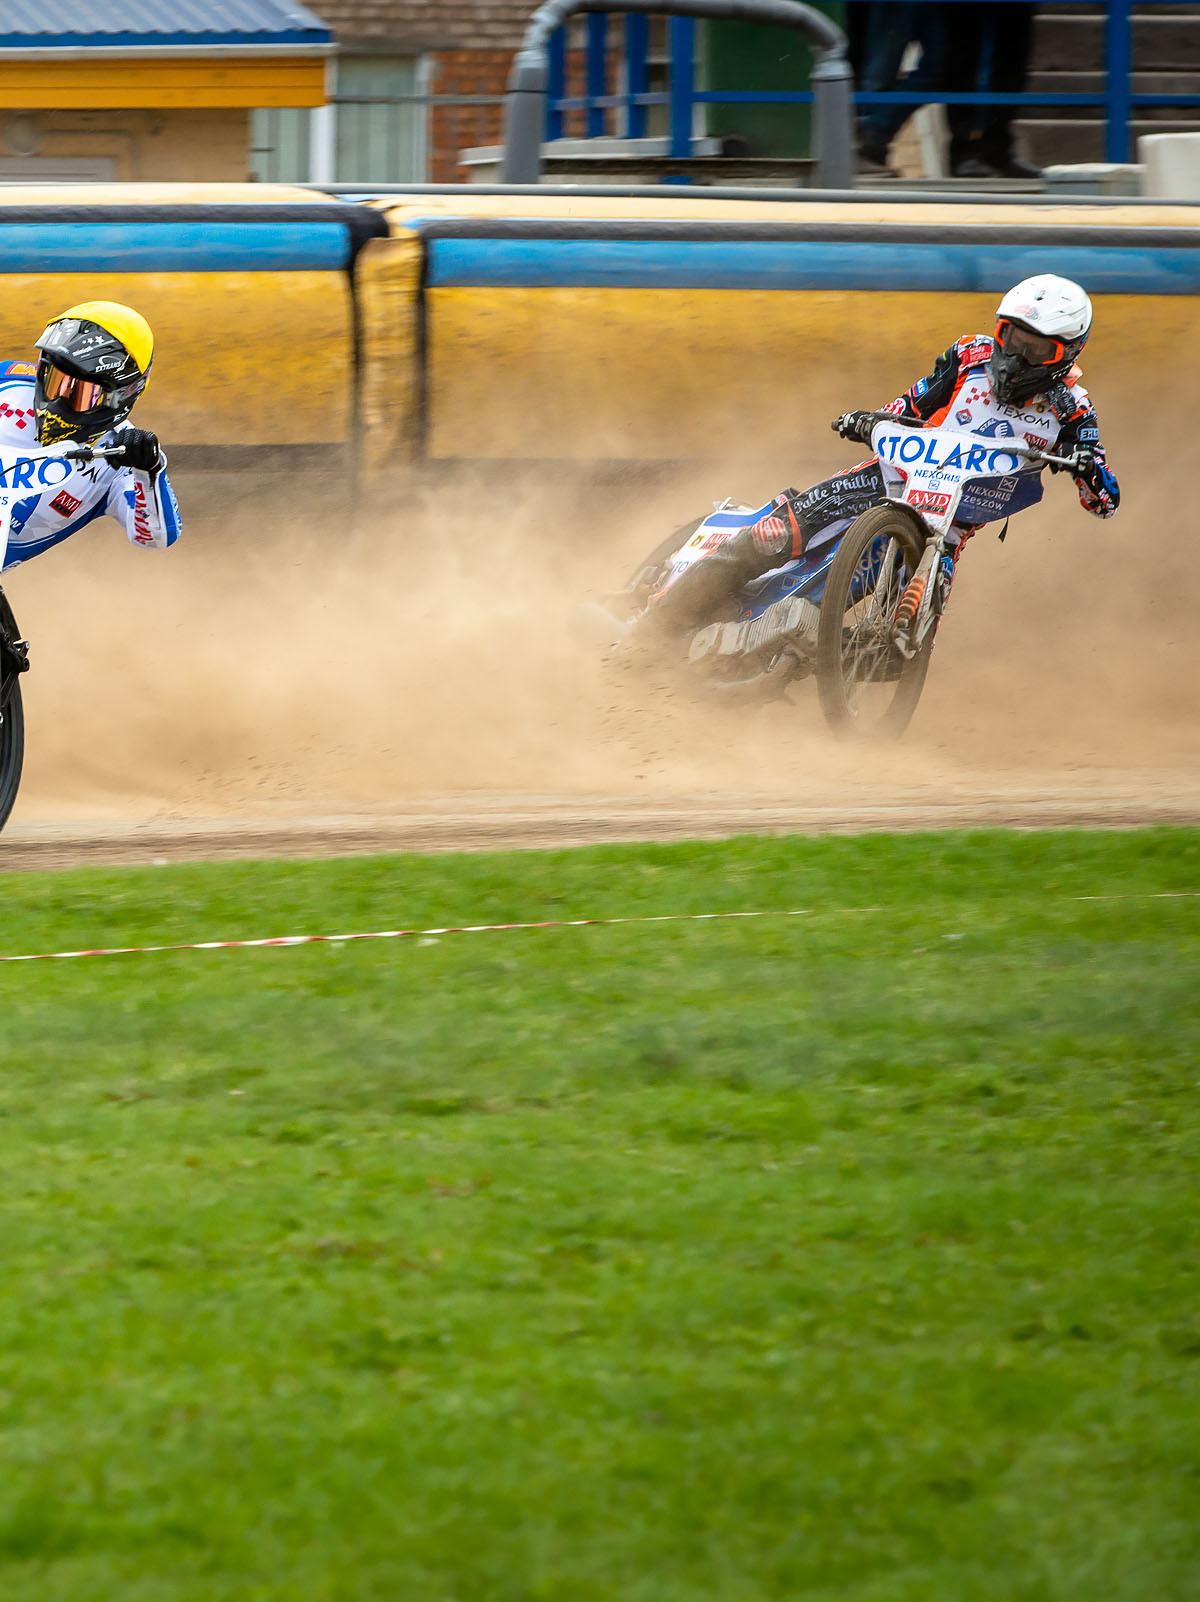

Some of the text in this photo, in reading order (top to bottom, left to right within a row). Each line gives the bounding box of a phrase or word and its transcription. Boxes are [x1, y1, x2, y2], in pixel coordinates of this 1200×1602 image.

[996, 402, 1051, 429] TEXOM
[1025, 433, 1047, 447] AMD
[877, 435, 1018, 473] STOLARO
[914, 468, 960, 483] NEXORIS
[909, 492, 950, 507] AMD
[967, 485, 1012, 502] NEXORIS
[963, 494, 1004, 511] zeszów
